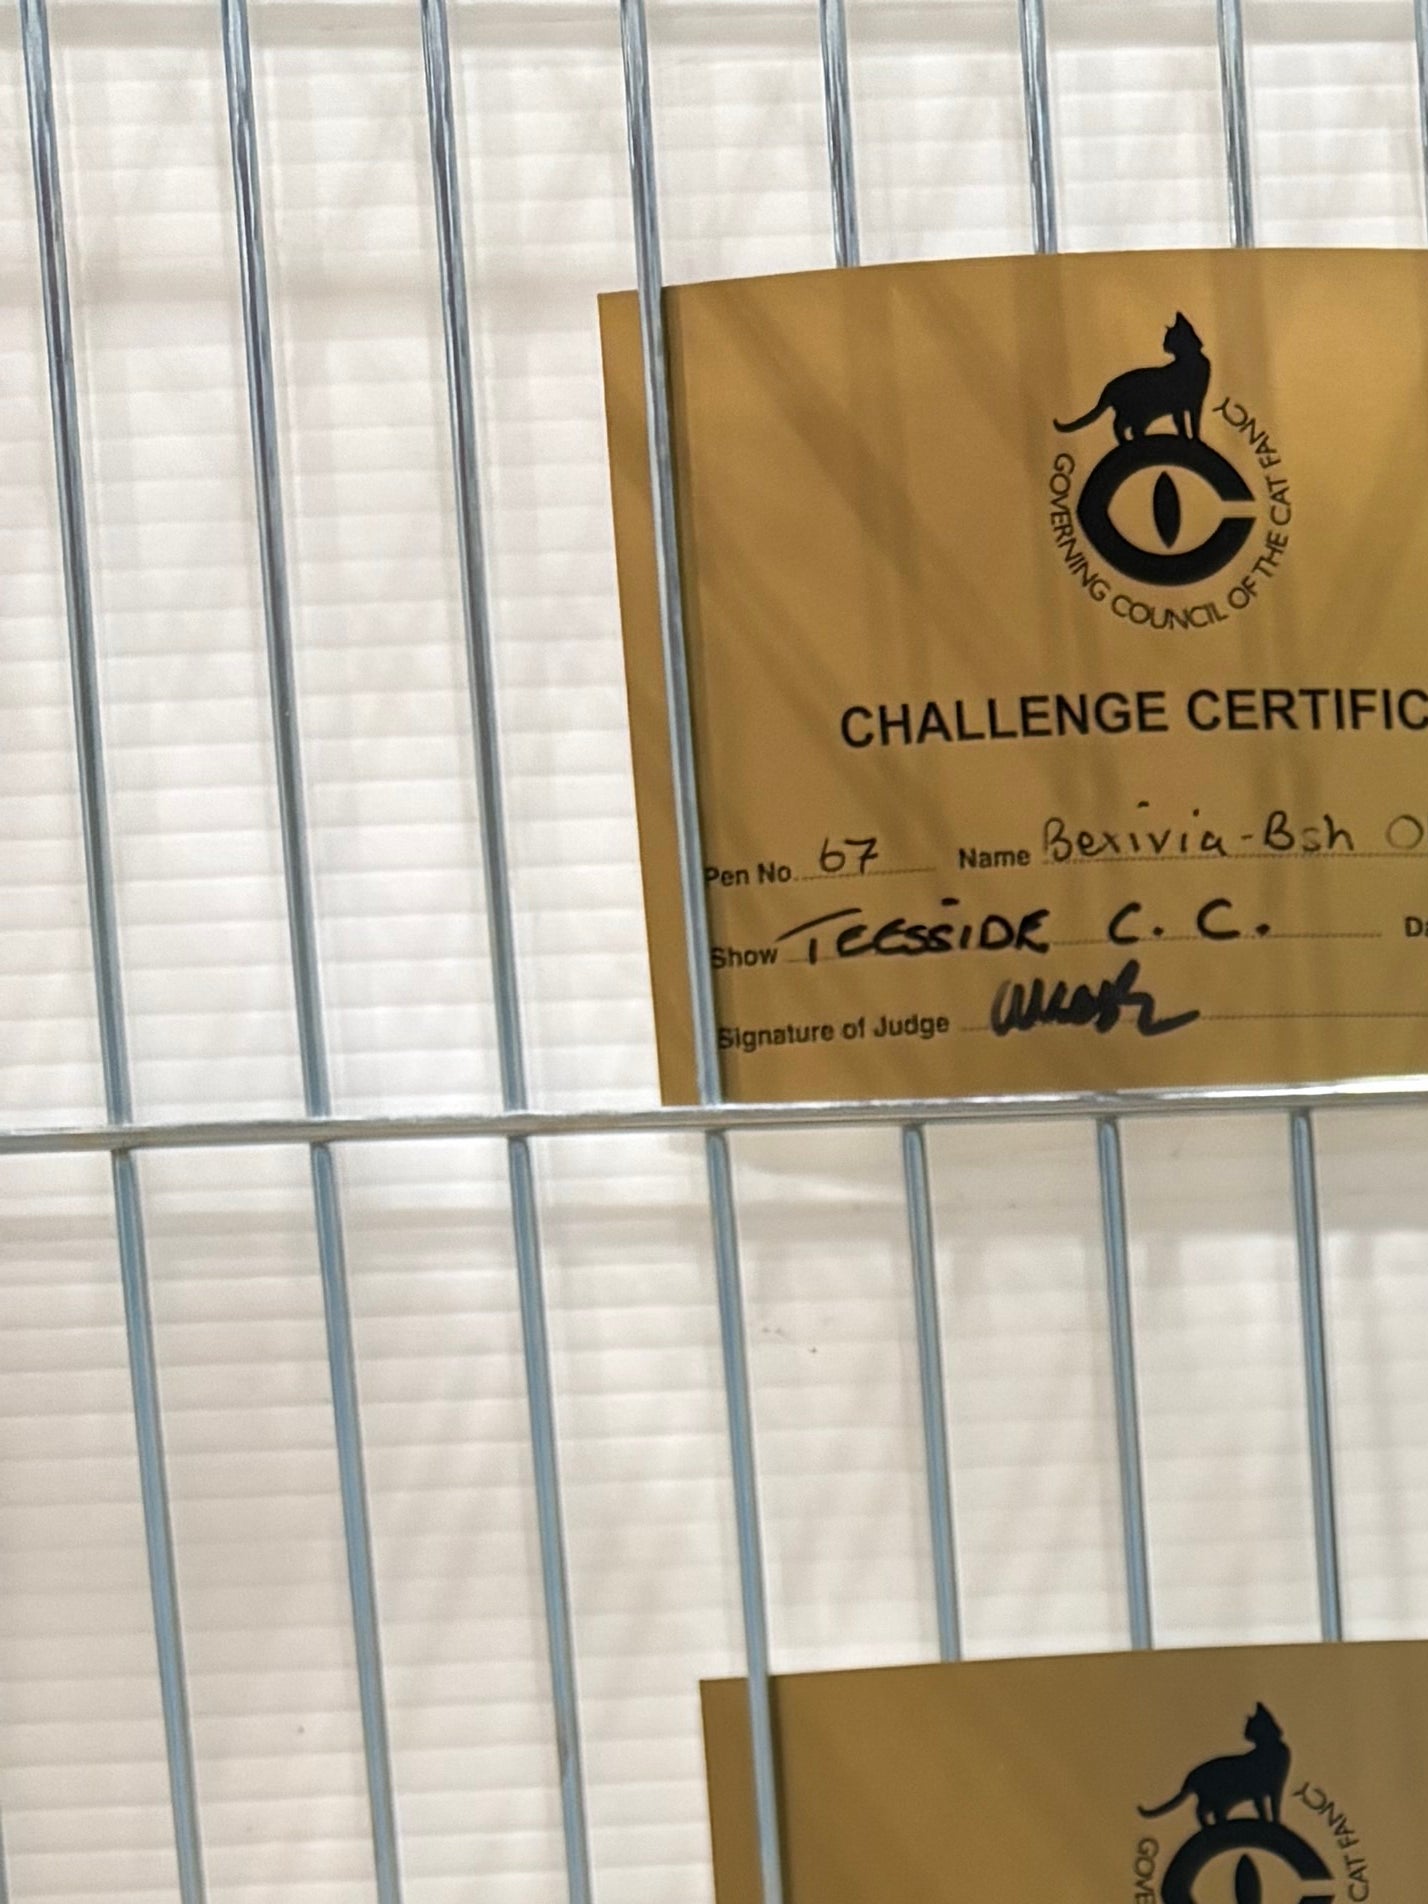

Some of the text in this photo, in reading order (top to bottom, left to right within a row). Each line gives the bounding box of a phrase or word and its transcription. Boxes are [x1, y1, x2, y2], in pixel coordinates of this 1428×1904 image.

[1050, 396, 1292, 630] GOVERNING COUNCIL OF THE CAT FANCY
[840, 690, 1169, 749] CHALLENGE
[819, 837, 879, 875] 67
[958, 846, 1031, 870] Name
[710, 945, 778, 969] Show
[716, 1012, 950, 1053] Signature of Judge
[1291, 1781, 1360, 1850] FANCY
[1343, 1854, 1370, 1903] CAT
